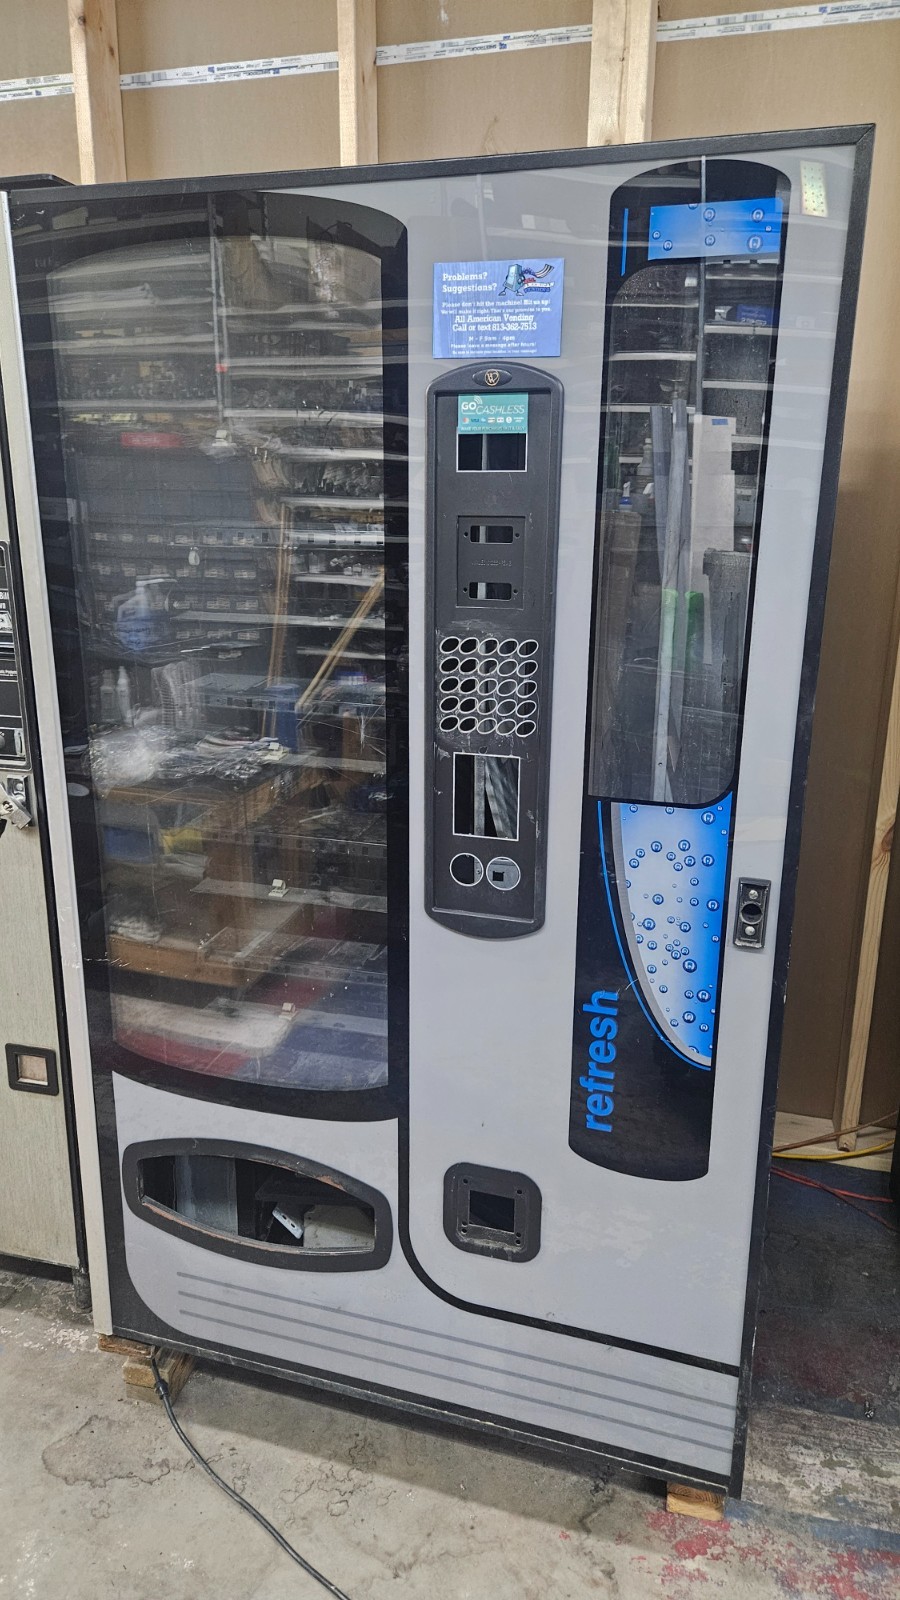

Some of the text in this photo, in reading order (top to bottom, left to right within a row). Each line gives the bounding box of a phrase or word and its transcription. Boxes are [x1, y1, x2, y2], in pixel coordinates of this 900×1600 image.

[442, 272, 488, 282] Problems?
[442, 283, 498, 294] Suggestions?
[503, 314, 534, 322] Vending
[461, 402, 477, 410] GO
[476, 404, 525, 414] CASHLESS
[580, 990, 620, 1132] refresh
